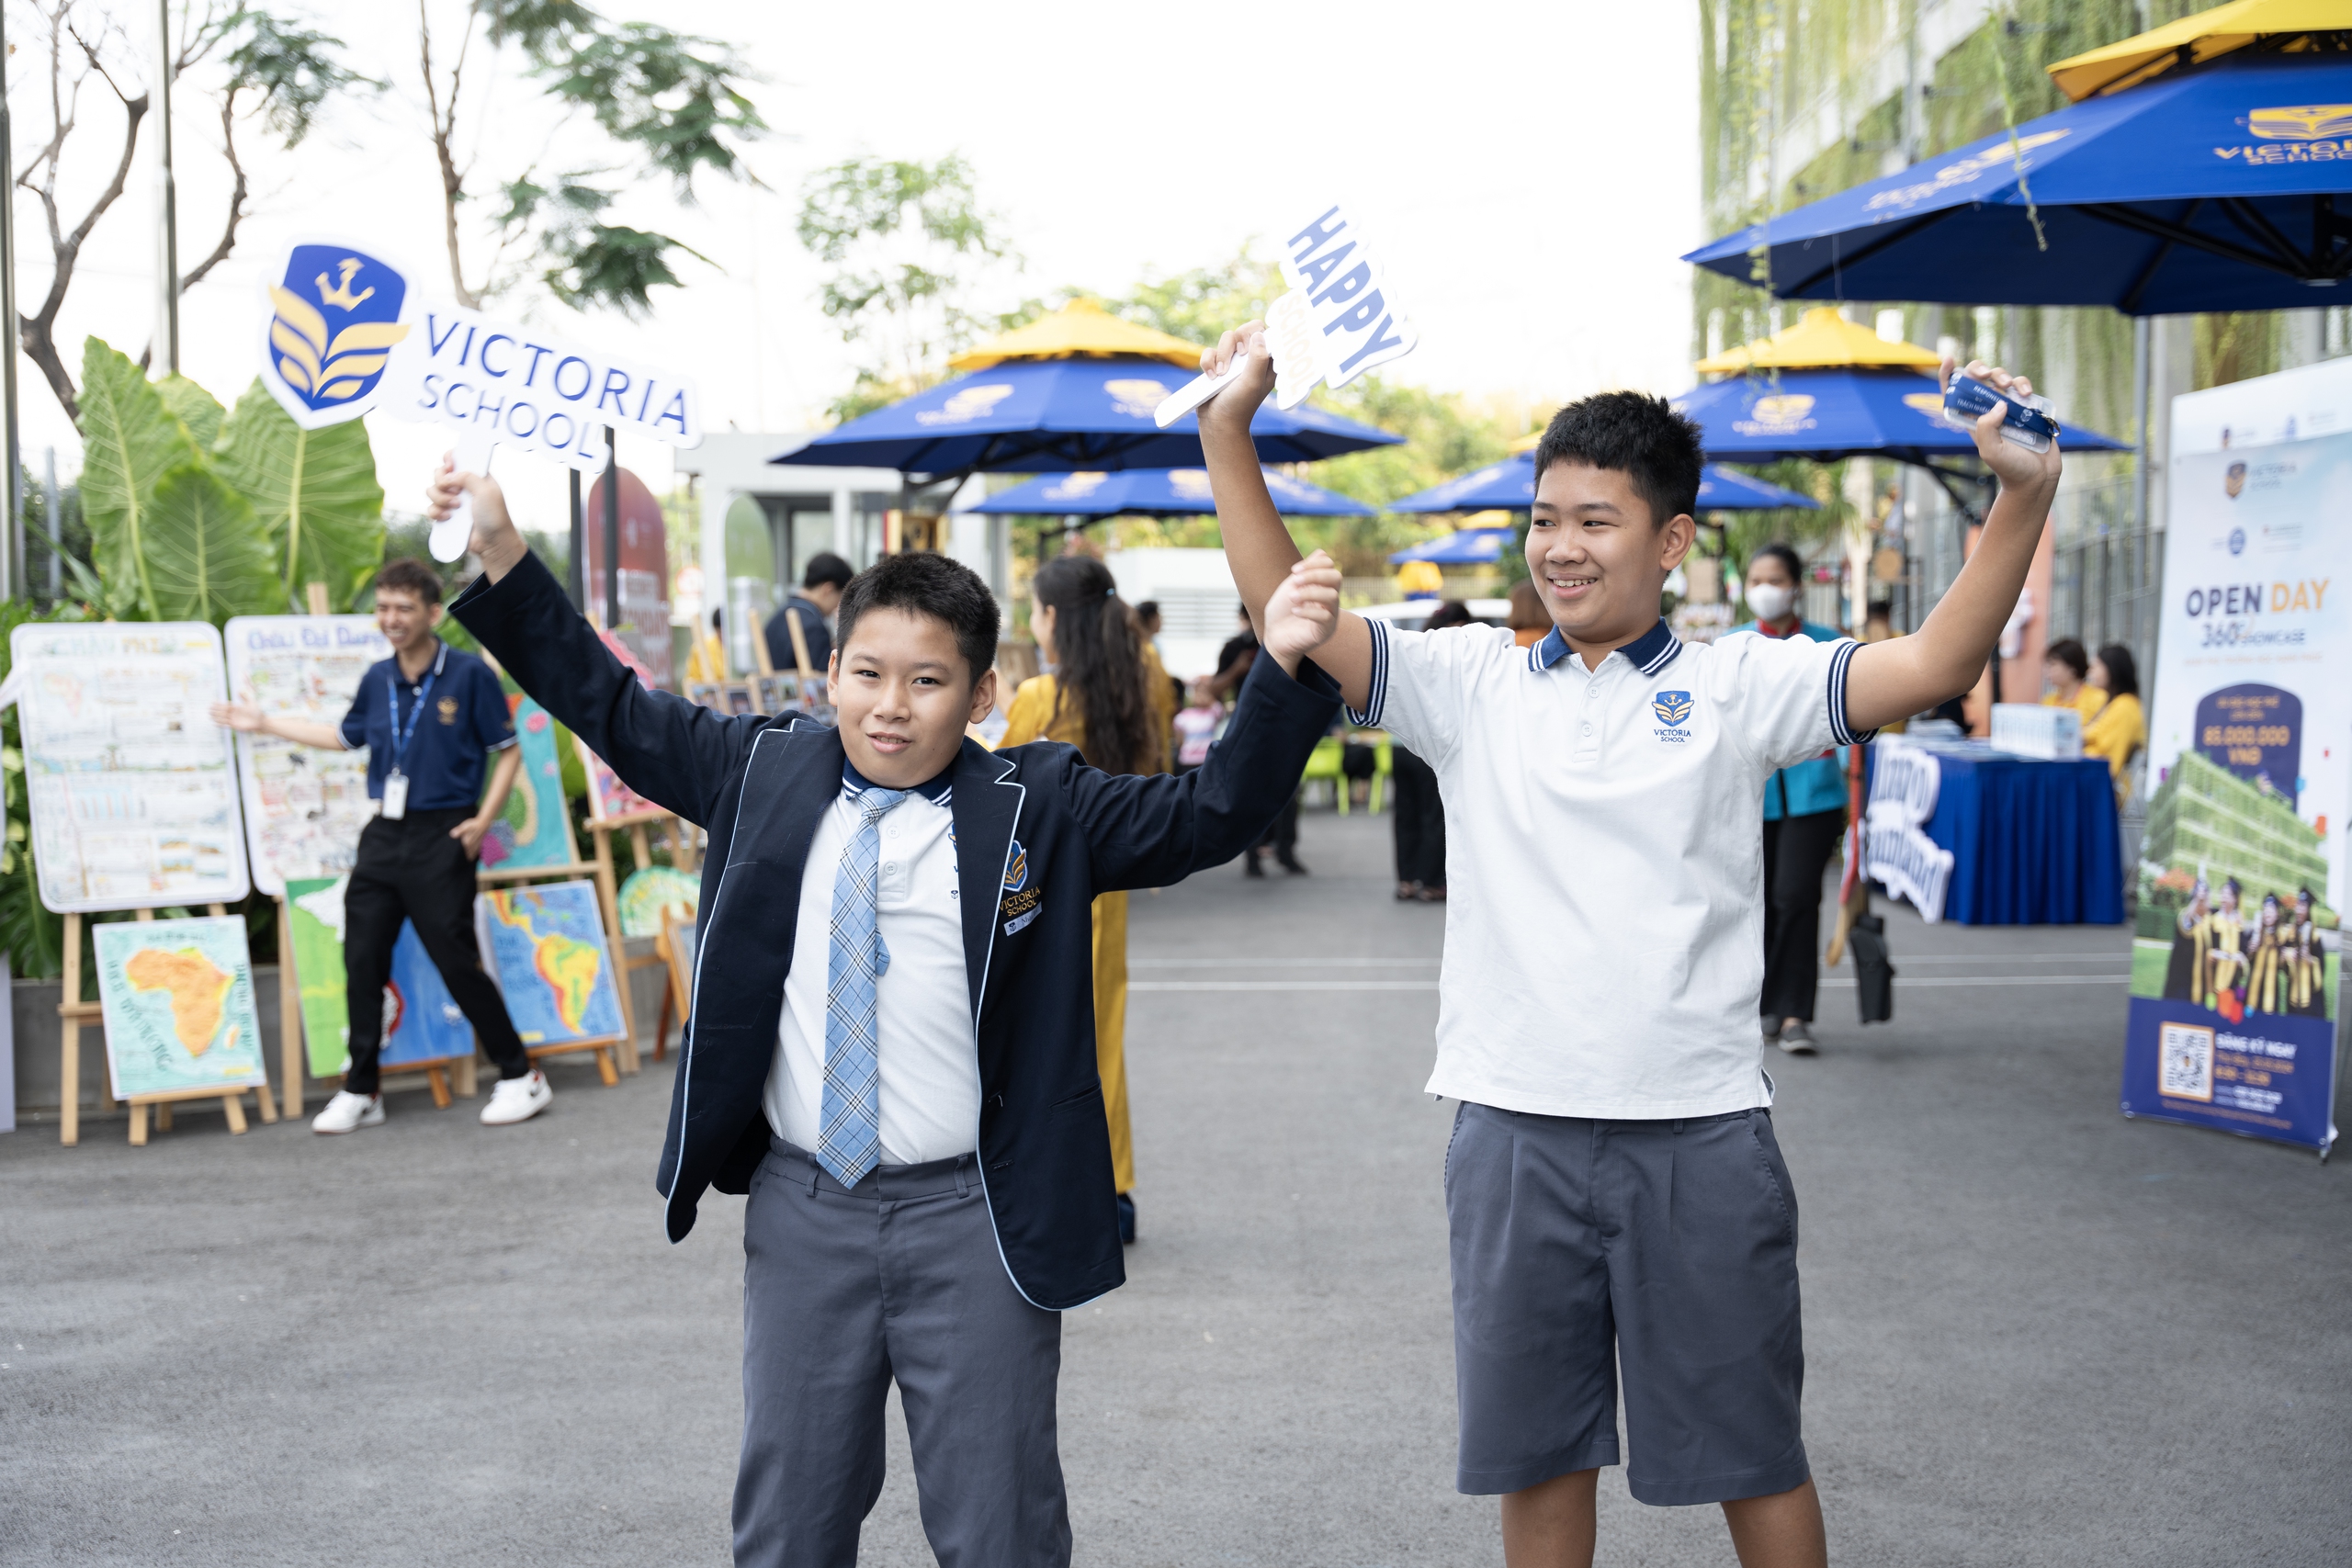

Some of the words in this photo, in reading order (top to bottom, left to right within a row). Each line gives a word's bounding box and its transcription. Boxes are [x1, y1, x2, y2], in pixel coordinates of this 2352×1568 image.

[1287, 205, 1402, 375] HAPPY
[427, 314, 689, 436] VICTORIA
[1278, 295, 1316, 397] SCHOOL
[419, 374, 595, 459] SCHOOL
[2185, 583, 2263, 617] OPEN
[2270, 578, 2330, 614] DAY
[999, 886, 1041, 911] VICTORIA
[1007, 899, 1036, 917] SCHOOL
